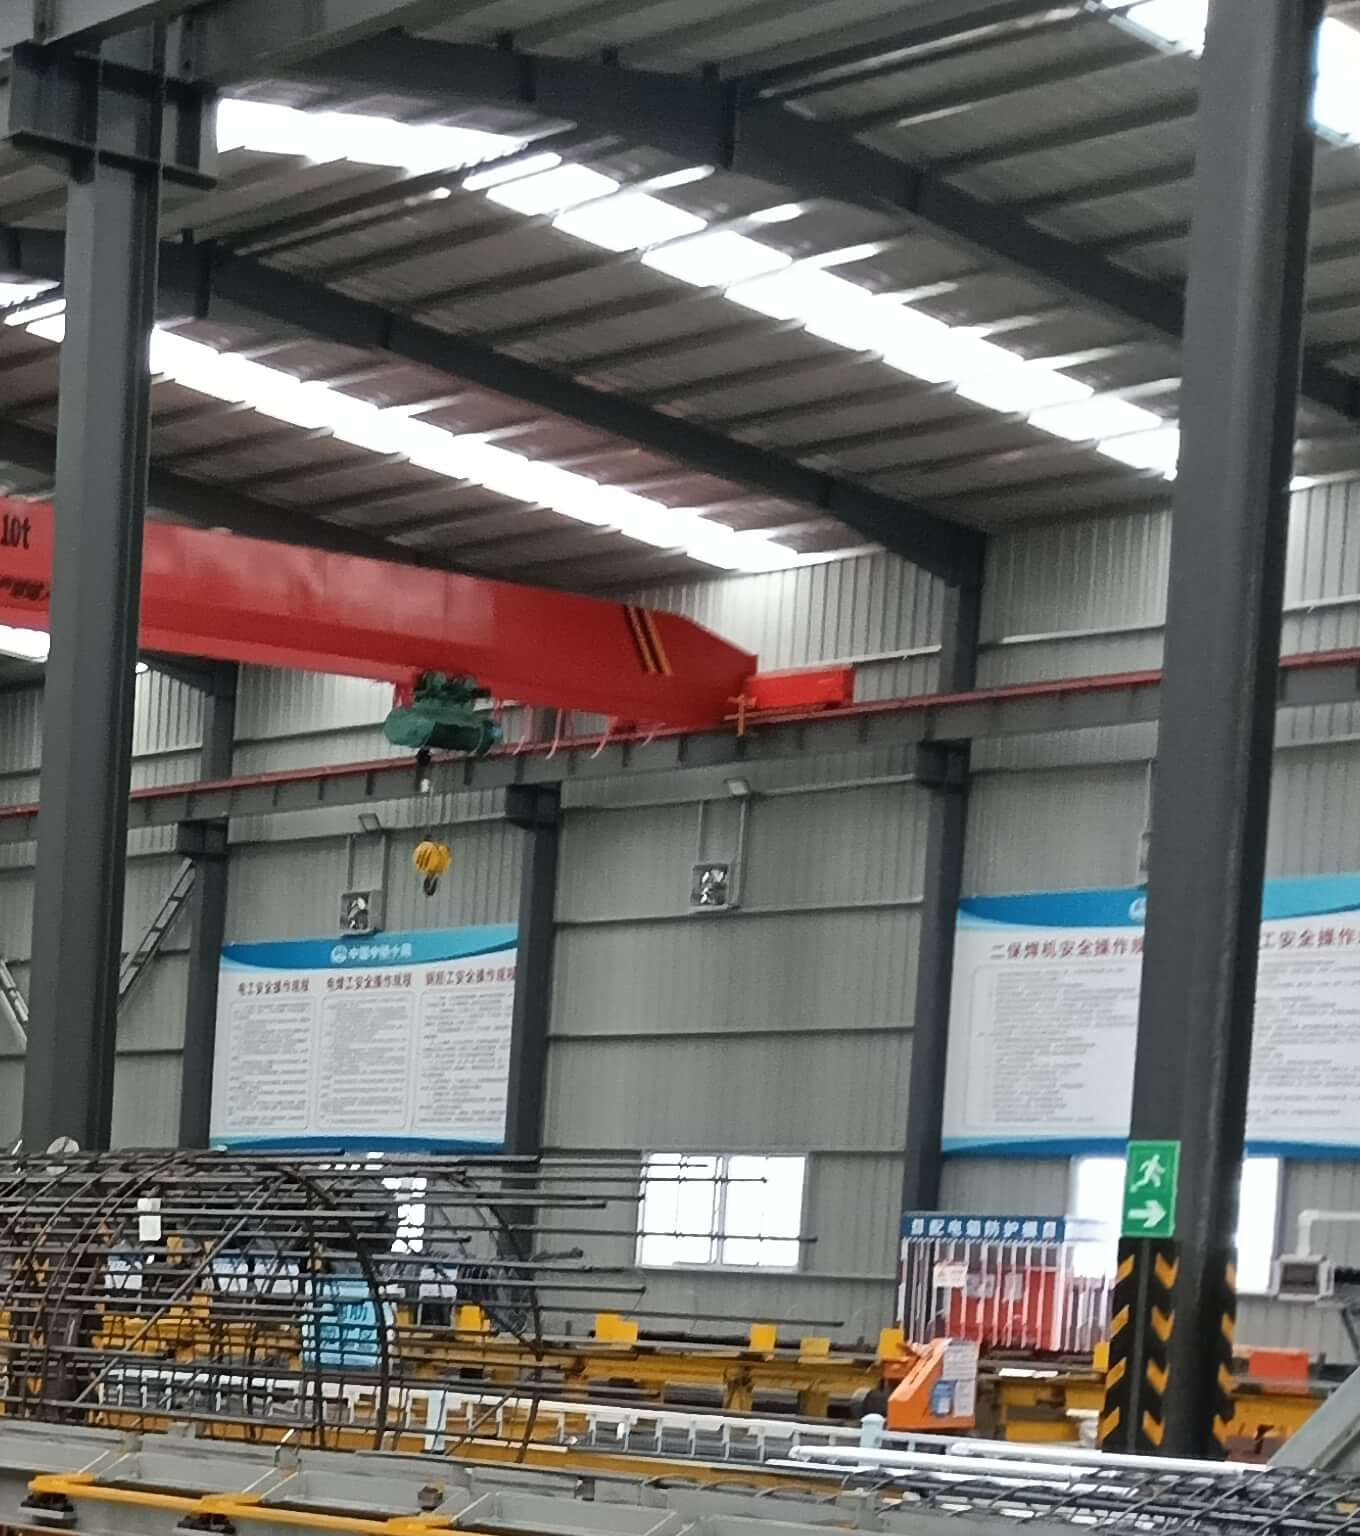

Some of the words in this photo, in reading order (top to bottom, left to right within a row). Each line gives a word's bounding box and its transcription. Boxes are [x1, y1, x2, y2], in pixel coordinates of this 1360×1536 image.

[0, 513, 32, 549] 10t
[1263, 928, 1360, 950] 工安全操作
